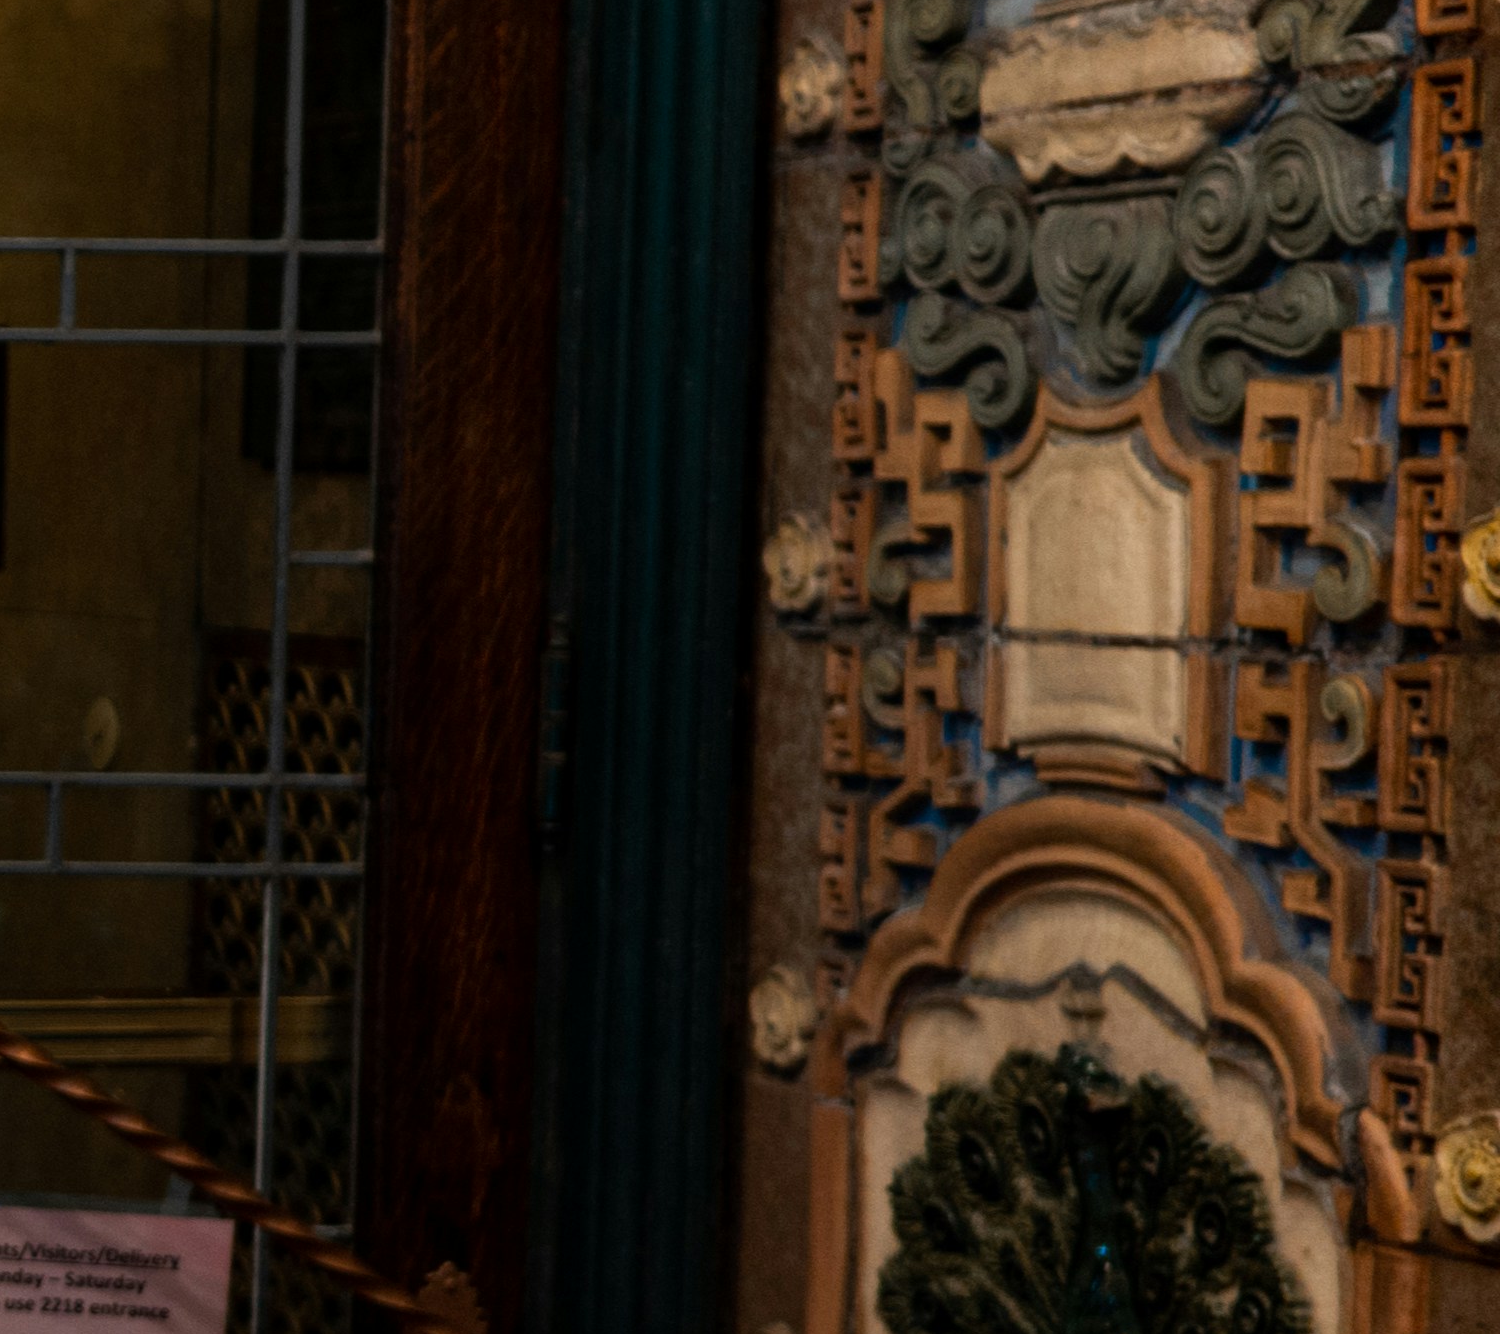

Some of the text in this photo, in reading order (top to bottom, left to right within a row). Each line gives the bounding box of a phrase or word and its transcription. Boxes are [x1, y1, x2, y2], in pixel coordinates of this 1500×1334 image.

[66, 1272, 145, 1294] Saturday
[4, 1300, 35, 1313] use
[40, 1297, 84, 1315] 2218
[89, 1301, 171, 1320] entrance
